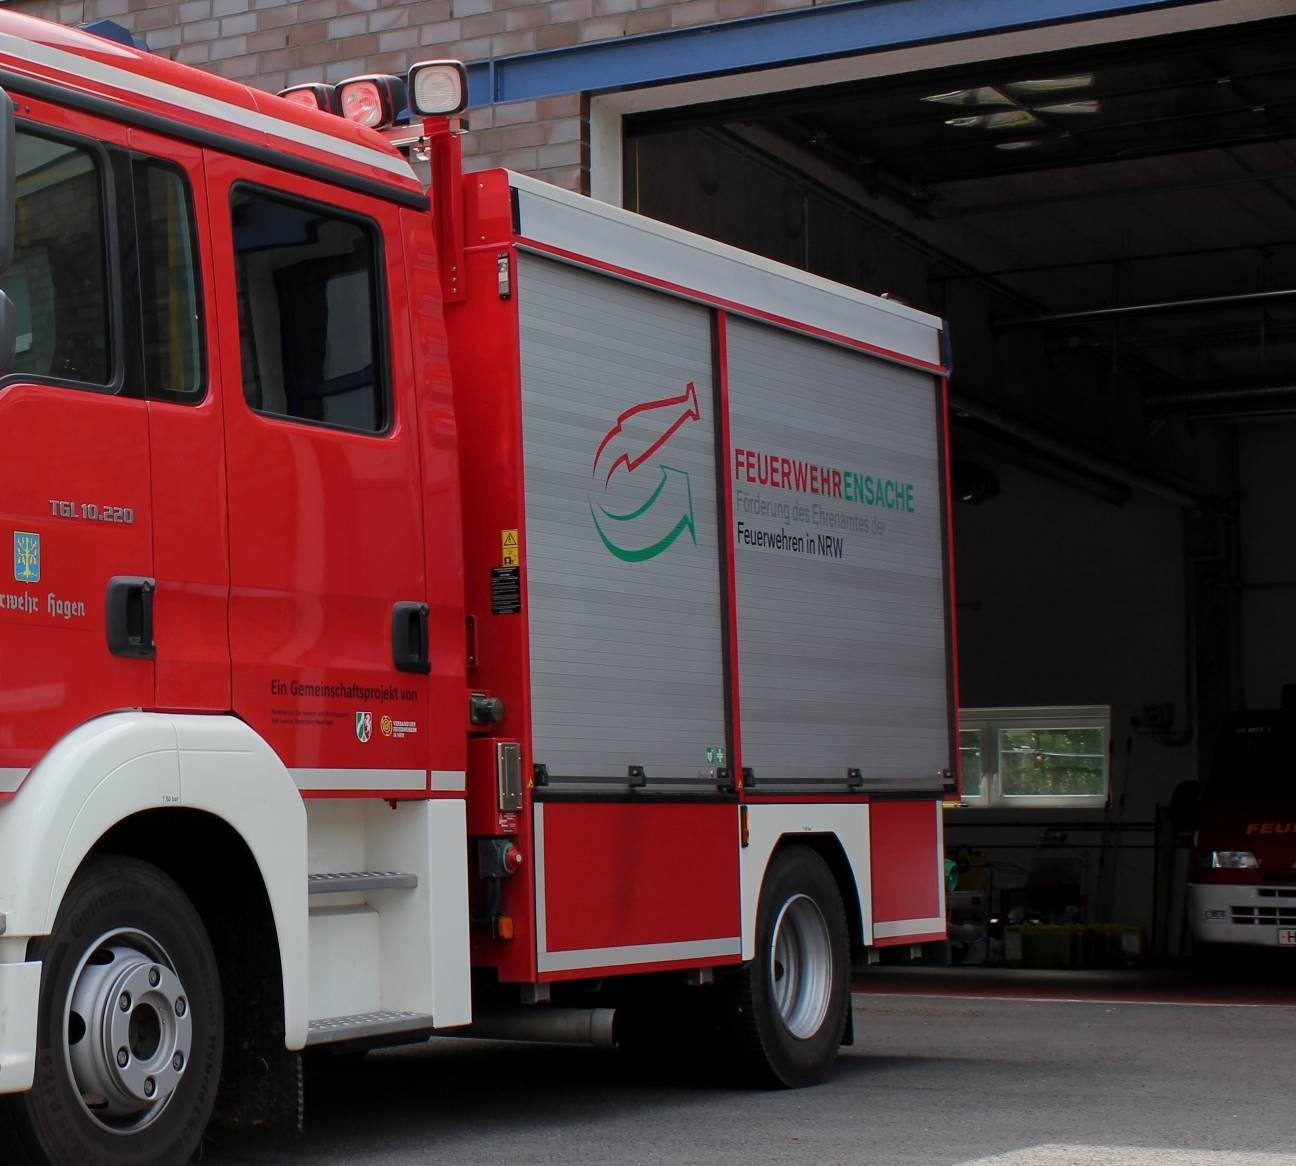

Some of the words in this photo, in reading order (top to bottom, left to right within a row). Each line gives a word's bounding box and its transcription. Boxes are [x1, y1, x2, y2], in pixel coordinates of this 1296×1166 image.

[734, 448, 915, 513] FEUERWEHRENSACHE
[49, 499, 79, 518] TGL
[81, 503, 135, 523] 10.220
[736, 489, 790, 525] Förderung
[792, 500, 810, 523] des
[812, 504, 869, 532] Ehrenamtes
[737, 521, 804, 552] Feuerwehren
[805, 533, 816, 555] in
[817, 534, 844, 559] NRW
[271, 679, 287, 696] Ein
[290, 681, 399, 703] Gemeinschaftsprojekt
[400, 689, 418, 701] von
